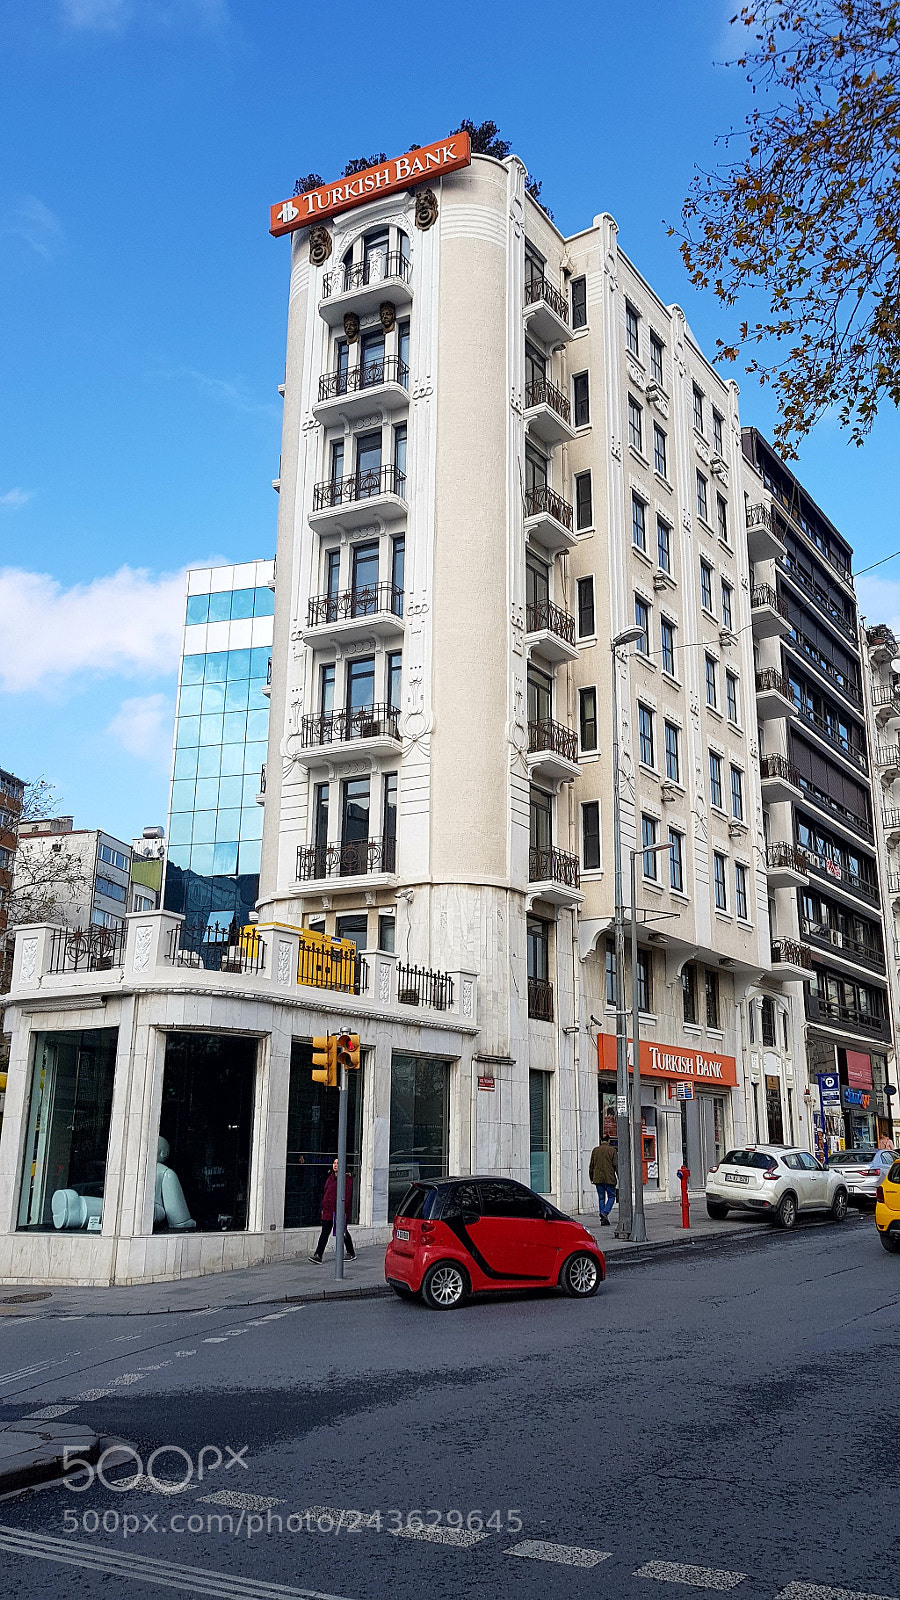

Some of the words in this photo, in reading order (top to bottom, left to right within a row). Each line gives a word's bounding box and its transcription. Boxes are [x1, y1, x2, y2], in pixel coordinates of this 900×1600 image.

[303, 168, 390, 214] TURKISH
[395, 143, 457, 182] BANK
[649, 1047, 694, 1075] TURKISH
[696, 1054, 723, 1079] BANK
